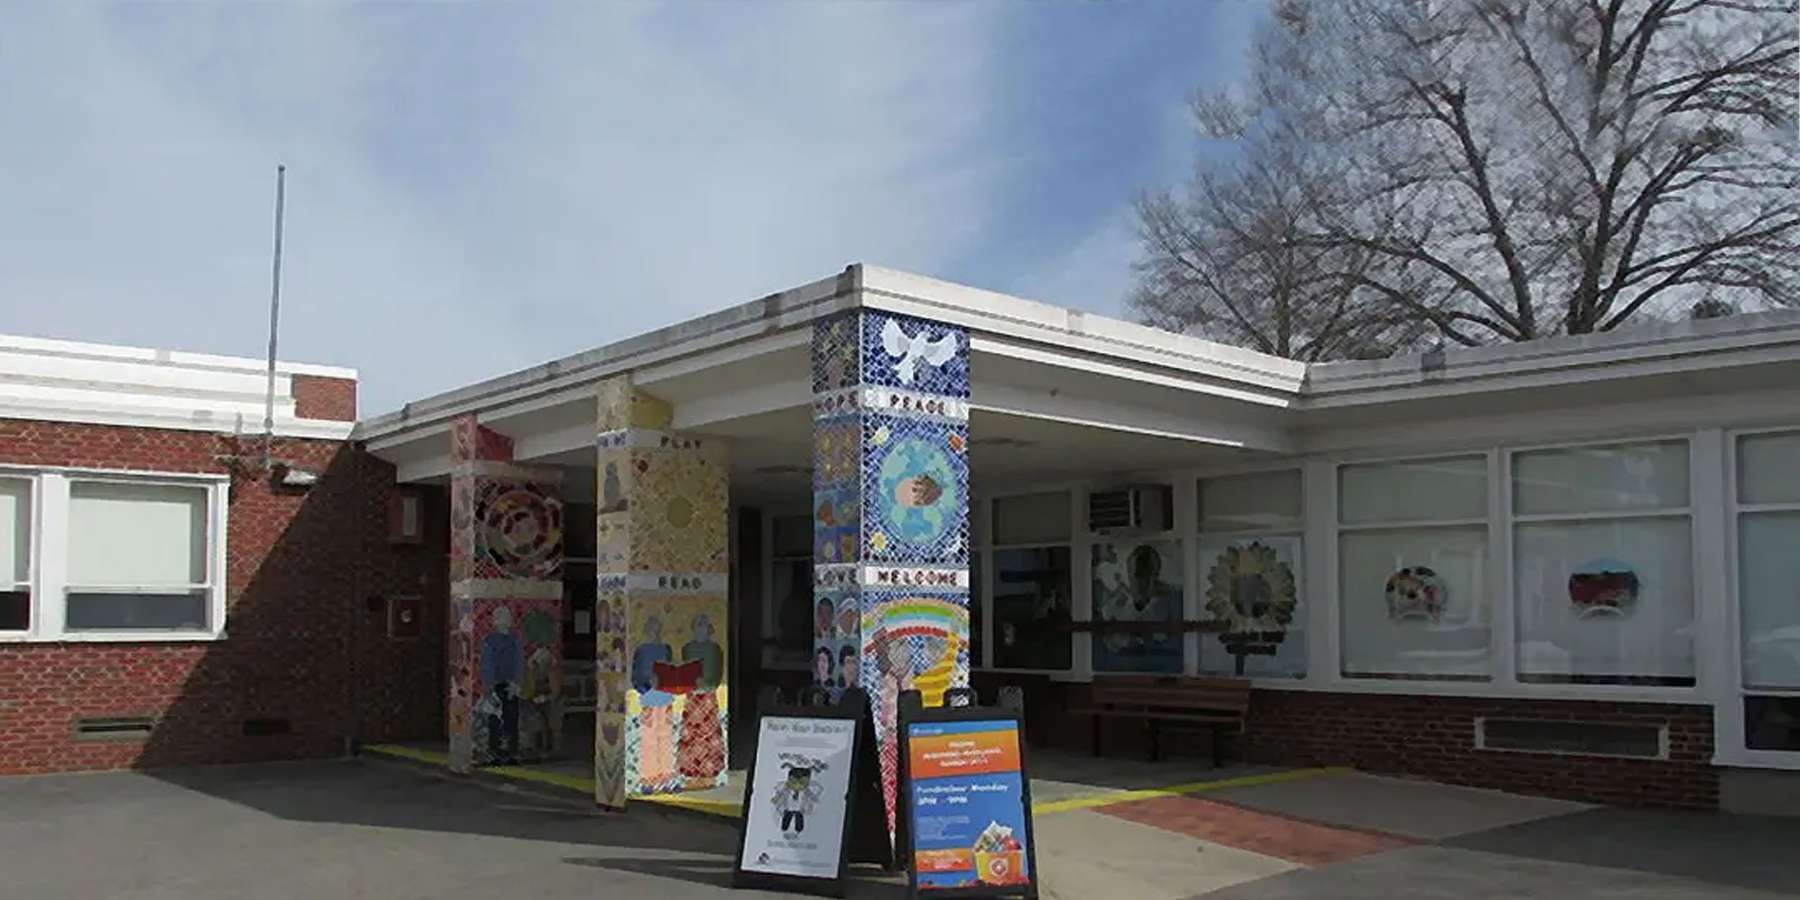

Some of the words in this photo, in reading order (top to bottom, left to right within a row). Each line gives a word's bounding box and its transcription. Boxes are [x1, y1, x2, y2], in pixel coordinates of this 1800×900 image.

[890, 393, 946, 415] PEACE
[660, 435, 703, 450] PLAY
[658, 576, 703, 590] READ
[878, 569, 957, 587] WELCOME
